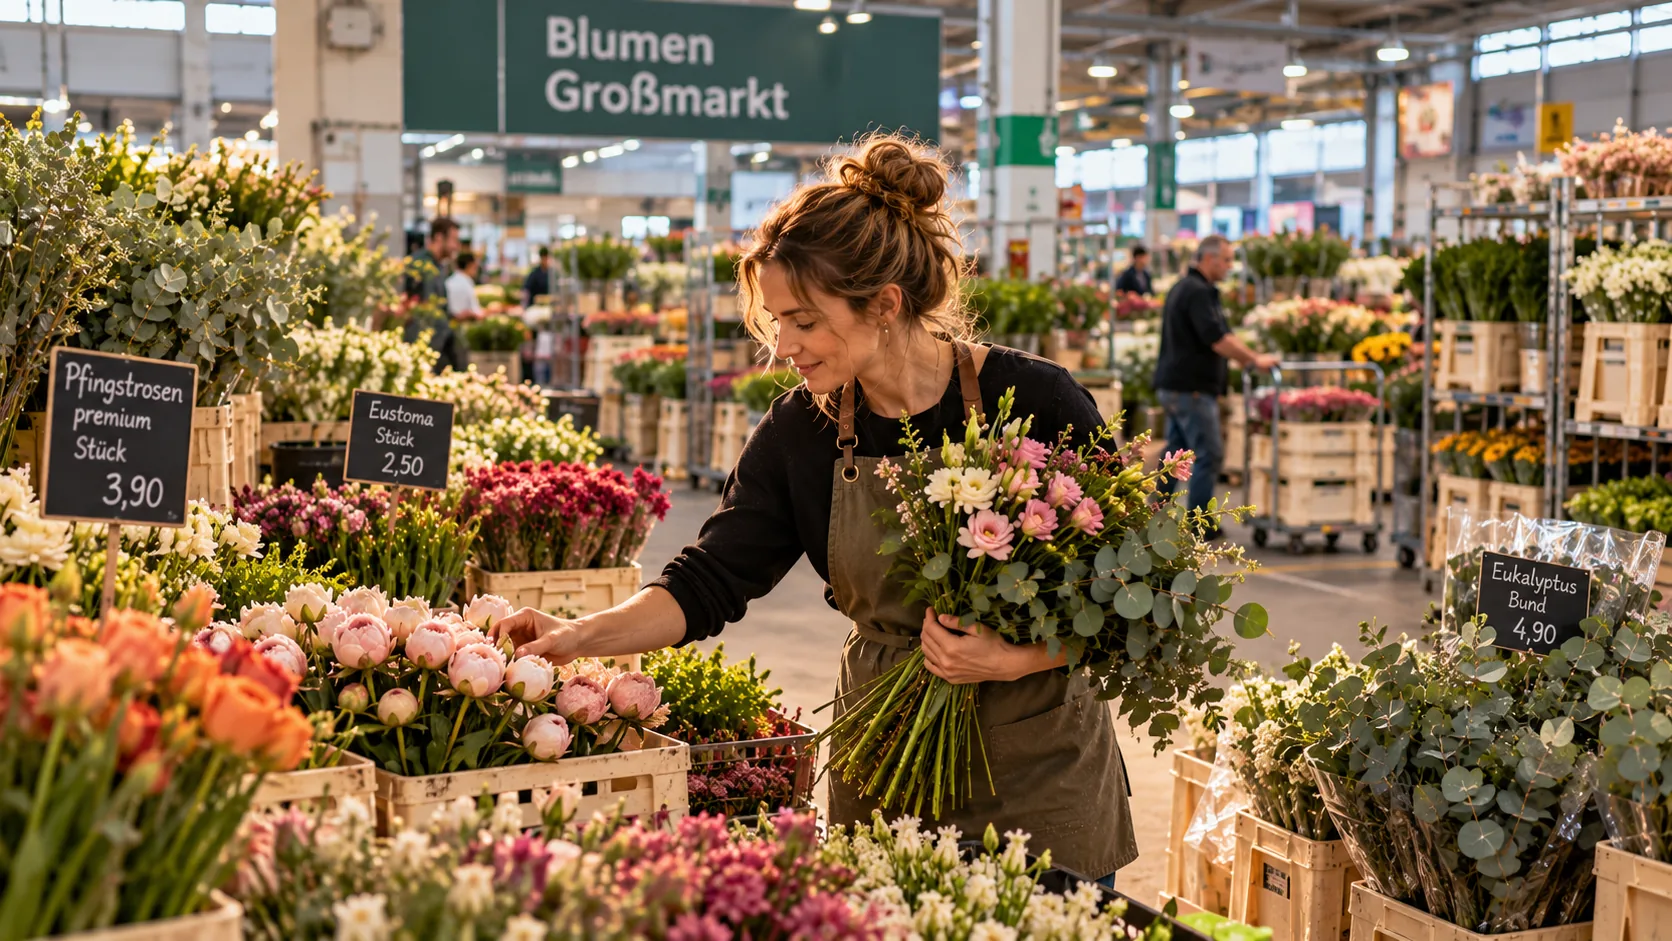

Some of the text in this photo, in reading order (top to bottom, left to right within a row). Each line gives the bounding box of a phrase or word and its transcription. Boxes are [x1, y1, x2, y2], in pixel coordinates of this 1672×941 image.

[546, 15, 714, 66] Blumen
[545, 69, 789, 120] Großmarkt
[65, 361, 184, 405] Pfingstrosen
[72, 407, 152, 431] premium
[369, 400, 434, 427] Eustoma
[74, 435, 127, 463] Stück
[375, 426, 415, 448] Stück
[381, 452, 424, 477] 2,50
[102, 472, 164, 511] 3,90
[1492, 562, 1577, 595] Eukalyptus
[1508, 590, 1547, 614] Bund
[1513, 617, 1557, 645] 4,90
